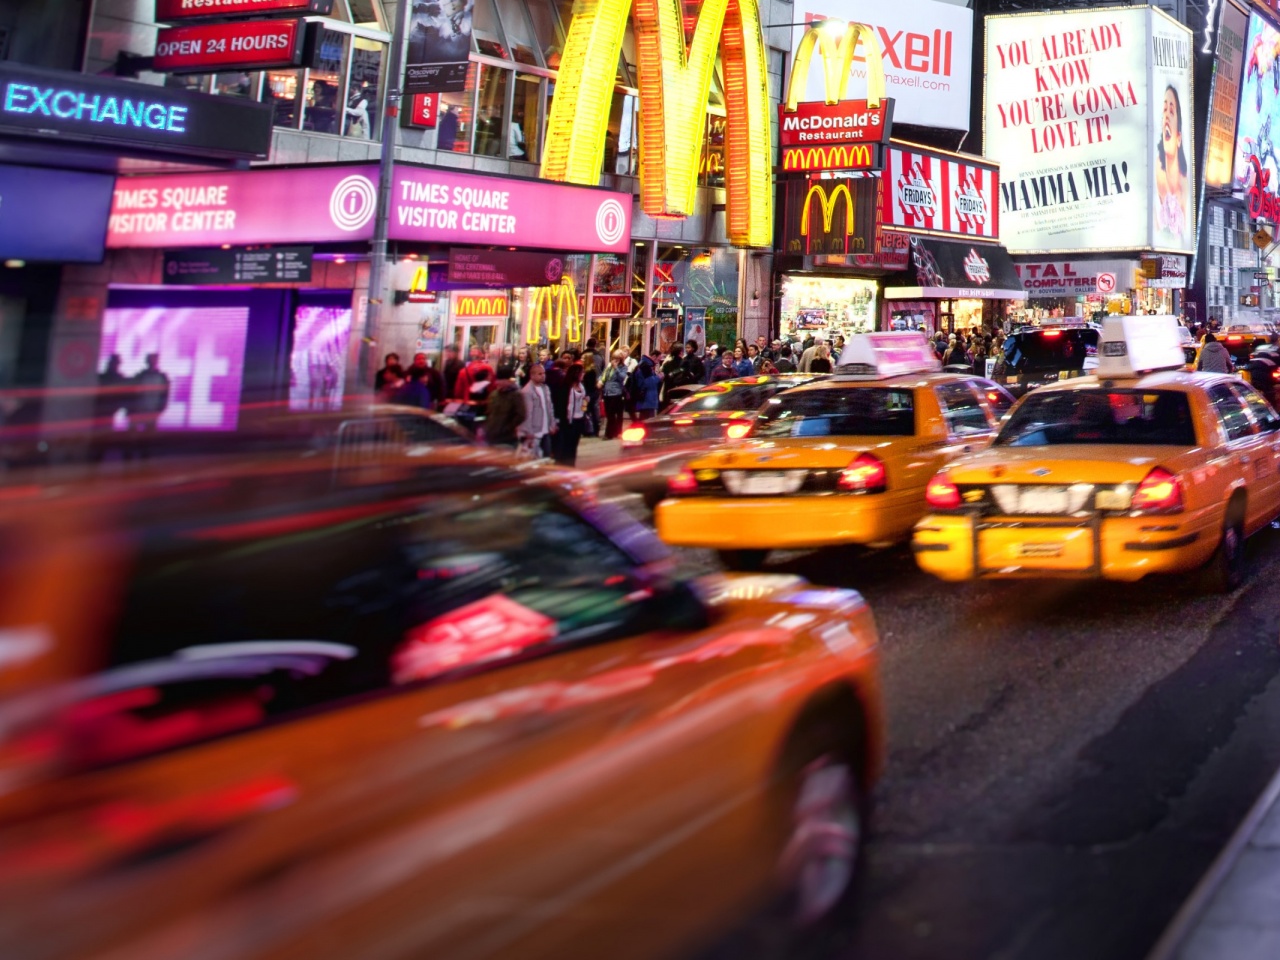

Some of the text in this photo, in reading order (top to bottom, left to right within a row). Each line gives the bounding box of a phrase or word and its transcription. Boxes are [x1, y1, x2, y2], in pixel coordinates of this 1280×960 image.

[158, 34, 288, 56] OPEN 24 HOURS
[996, 21, 1123, 70] YOU ALREADY
[1153, 36, 1176, 66] MAMMA
[1034, 58, 1092, 93] KNOW
[4, 83, 188, 133] EXCHANGE
[997, 80, 1138, 129] YOU'RE GONNA
[783, 112, 880, 131] McDonald's
[799, 129, 863, 141] Restaurant
[1030, 113, 1112, 154] LOVE IT!
[161, 186, 228, 210] SQUARE
[401, 180, 509, 210] TIMES SQUARE
[999, 161, 1130, 213] MAMMA MIA!
[171, 210, 236, 232] CENTER
[398, 206, 516, 233] VISITOR CENTER
[1024, 277, 1097, 289] COMPUTERS
